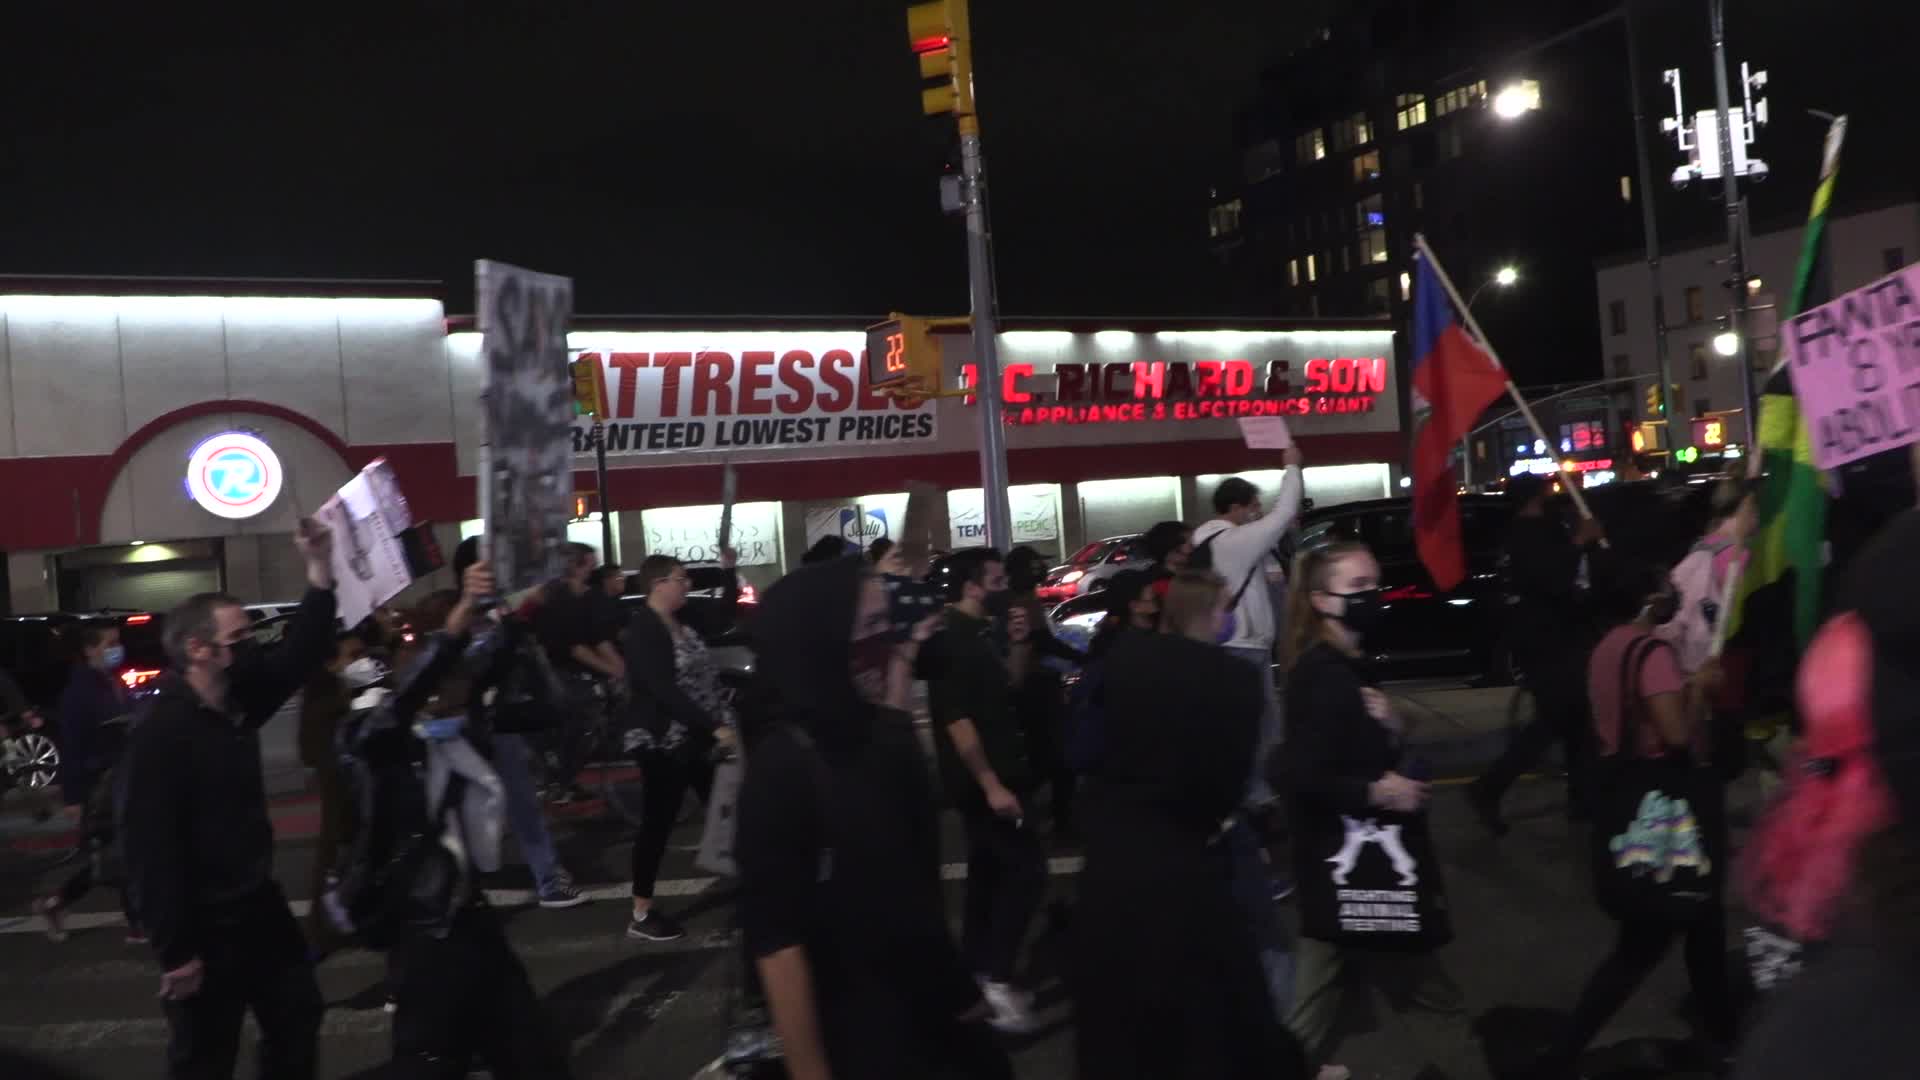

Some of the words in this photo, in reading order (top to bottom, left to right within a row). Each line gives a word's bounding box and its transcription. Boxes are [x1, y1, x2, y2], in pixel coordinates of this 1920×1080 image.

[887, 333, 905, 372] 22
[570, 349, 925, 419] ATTRESSE
[1052, 361, 1254, 402] RICHARD
[1304, 357, 1387, 394] SON
[1020, 404, 1146, 425] APPLIANCE
[1173, 397, 1311, 420] ELECTRONICS
[571, 421, 705, 452] RANTEED
[715, 417, 831, 446] LOWEST
[838, 413, 933, 442] PRICES
[956, 524, 988, 538] TEM
[673, 540, 768, 562] FOSER
